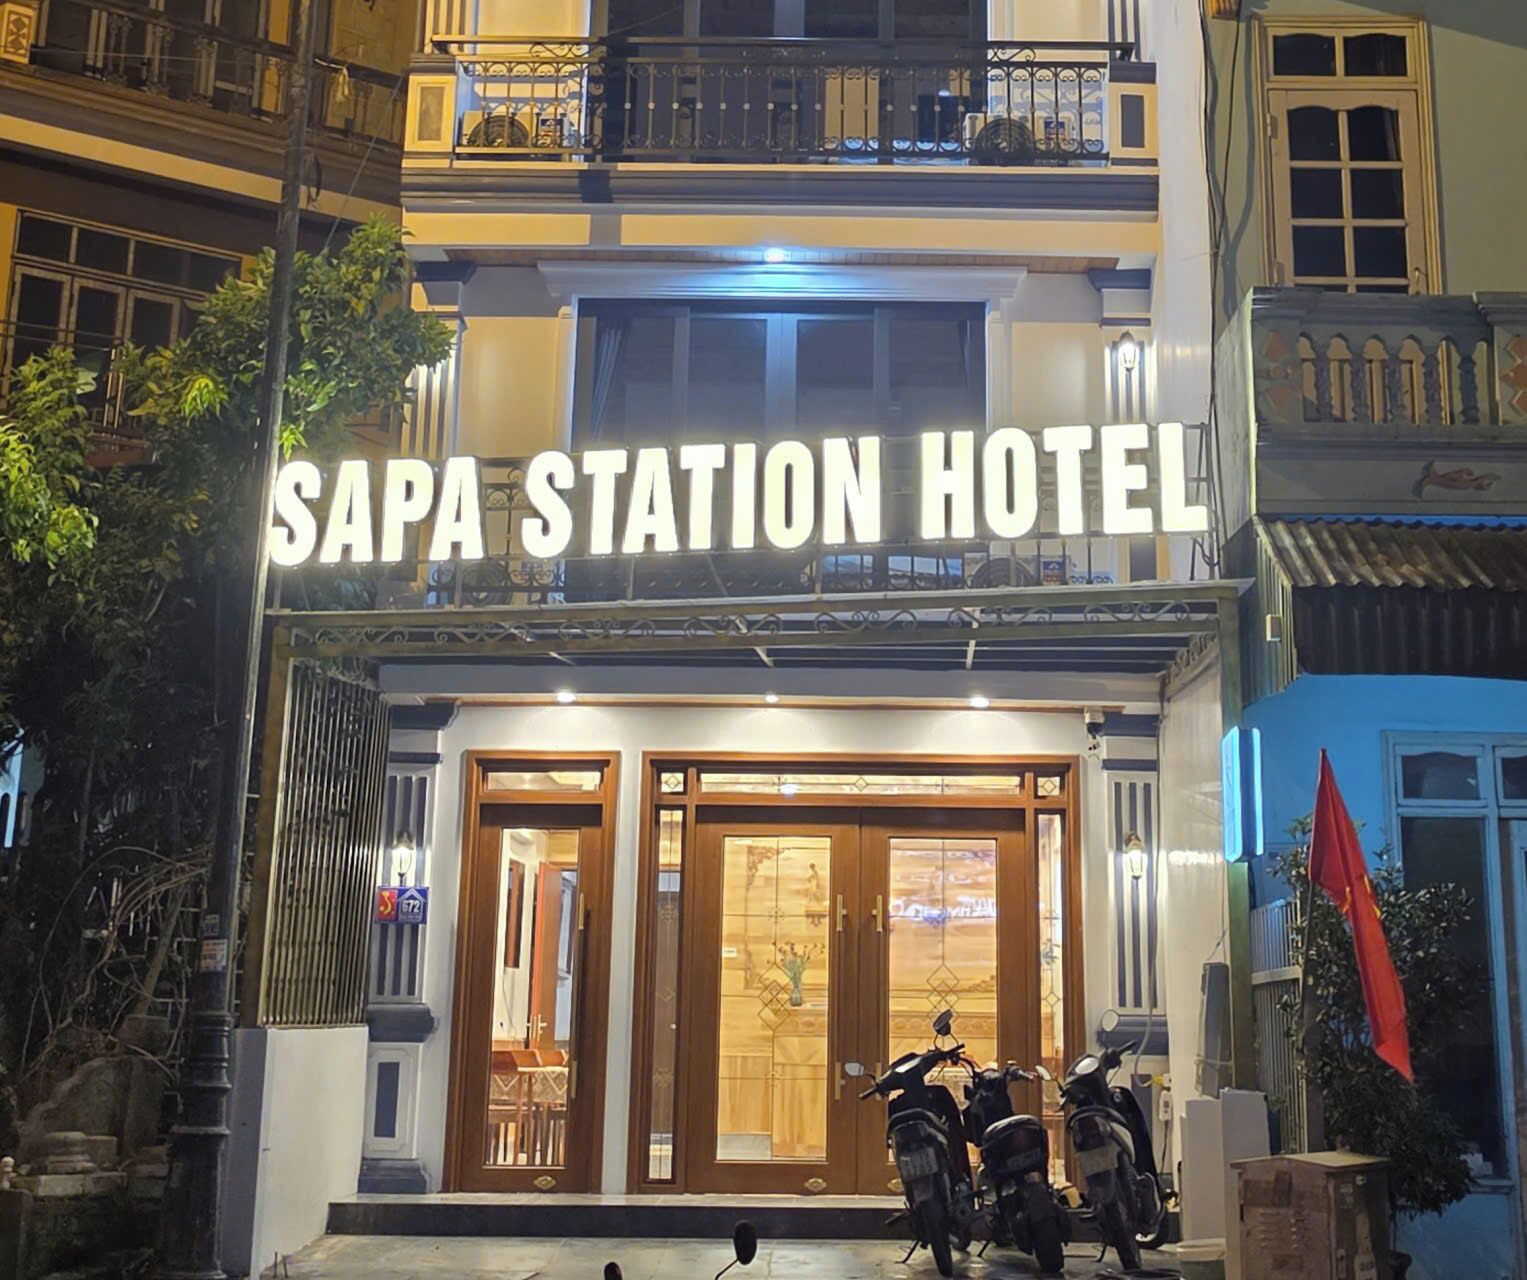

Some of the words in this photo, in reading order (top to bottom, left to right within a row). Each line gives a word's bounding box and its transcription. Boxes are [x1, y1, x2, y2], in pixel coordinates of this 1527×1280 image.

[269, 456, 484, 566] SAPA
[521, 436, 881, 558] STATION
[921, 422, 1208, 540] HOTEL
[402, 900, 421, 913] 672
